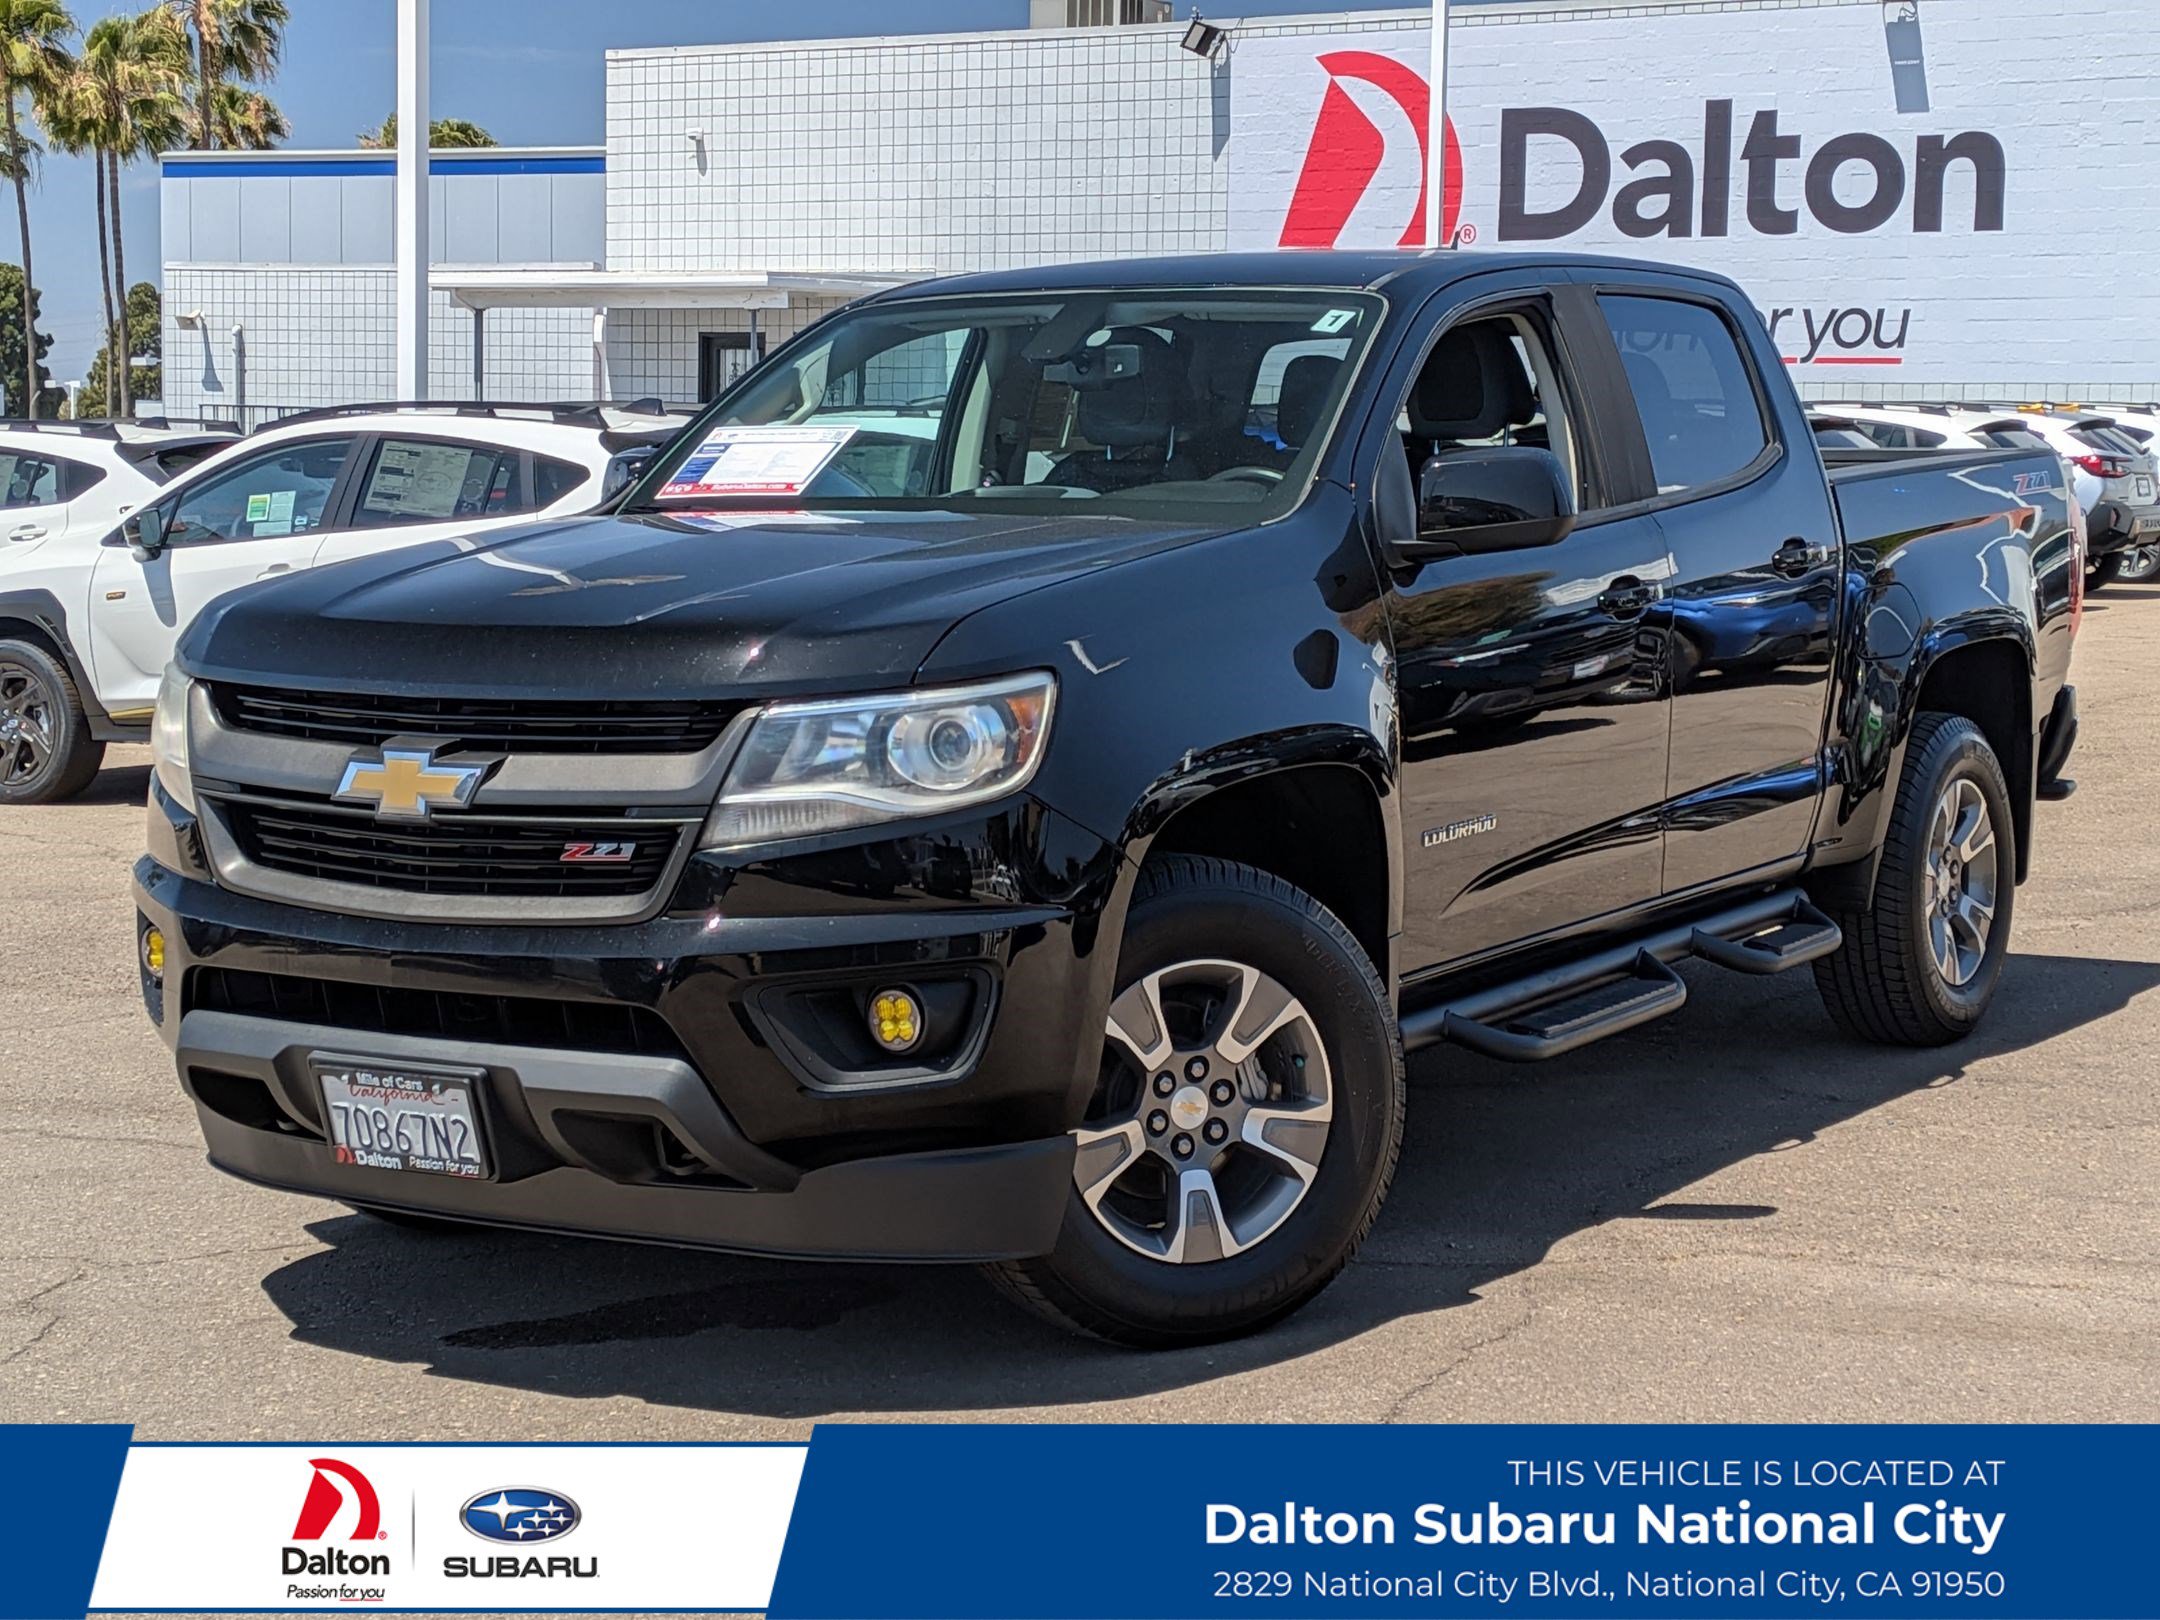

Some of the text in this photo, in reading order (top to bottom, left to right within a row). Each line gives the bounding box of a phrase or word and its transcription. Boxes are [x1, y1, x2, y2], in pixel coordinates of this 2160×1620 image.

[1498, 99, 2005, 241] Dalton
[1327, 313, 1343, 327] 1
[1800, 307, 1911, 364] you
[2013, 471, 2051, 496] Z71
[1423, 813, 1498, 848] COLORADO
[560, 842, 636, 862] Z71
[382, 1077, 394, 1087] of
[395, 1077, 424, 1091] Cars
[332, 1101, 476, 1163] 70867N2
[355, 1150, 480, 1176] Dalton Passion for you
